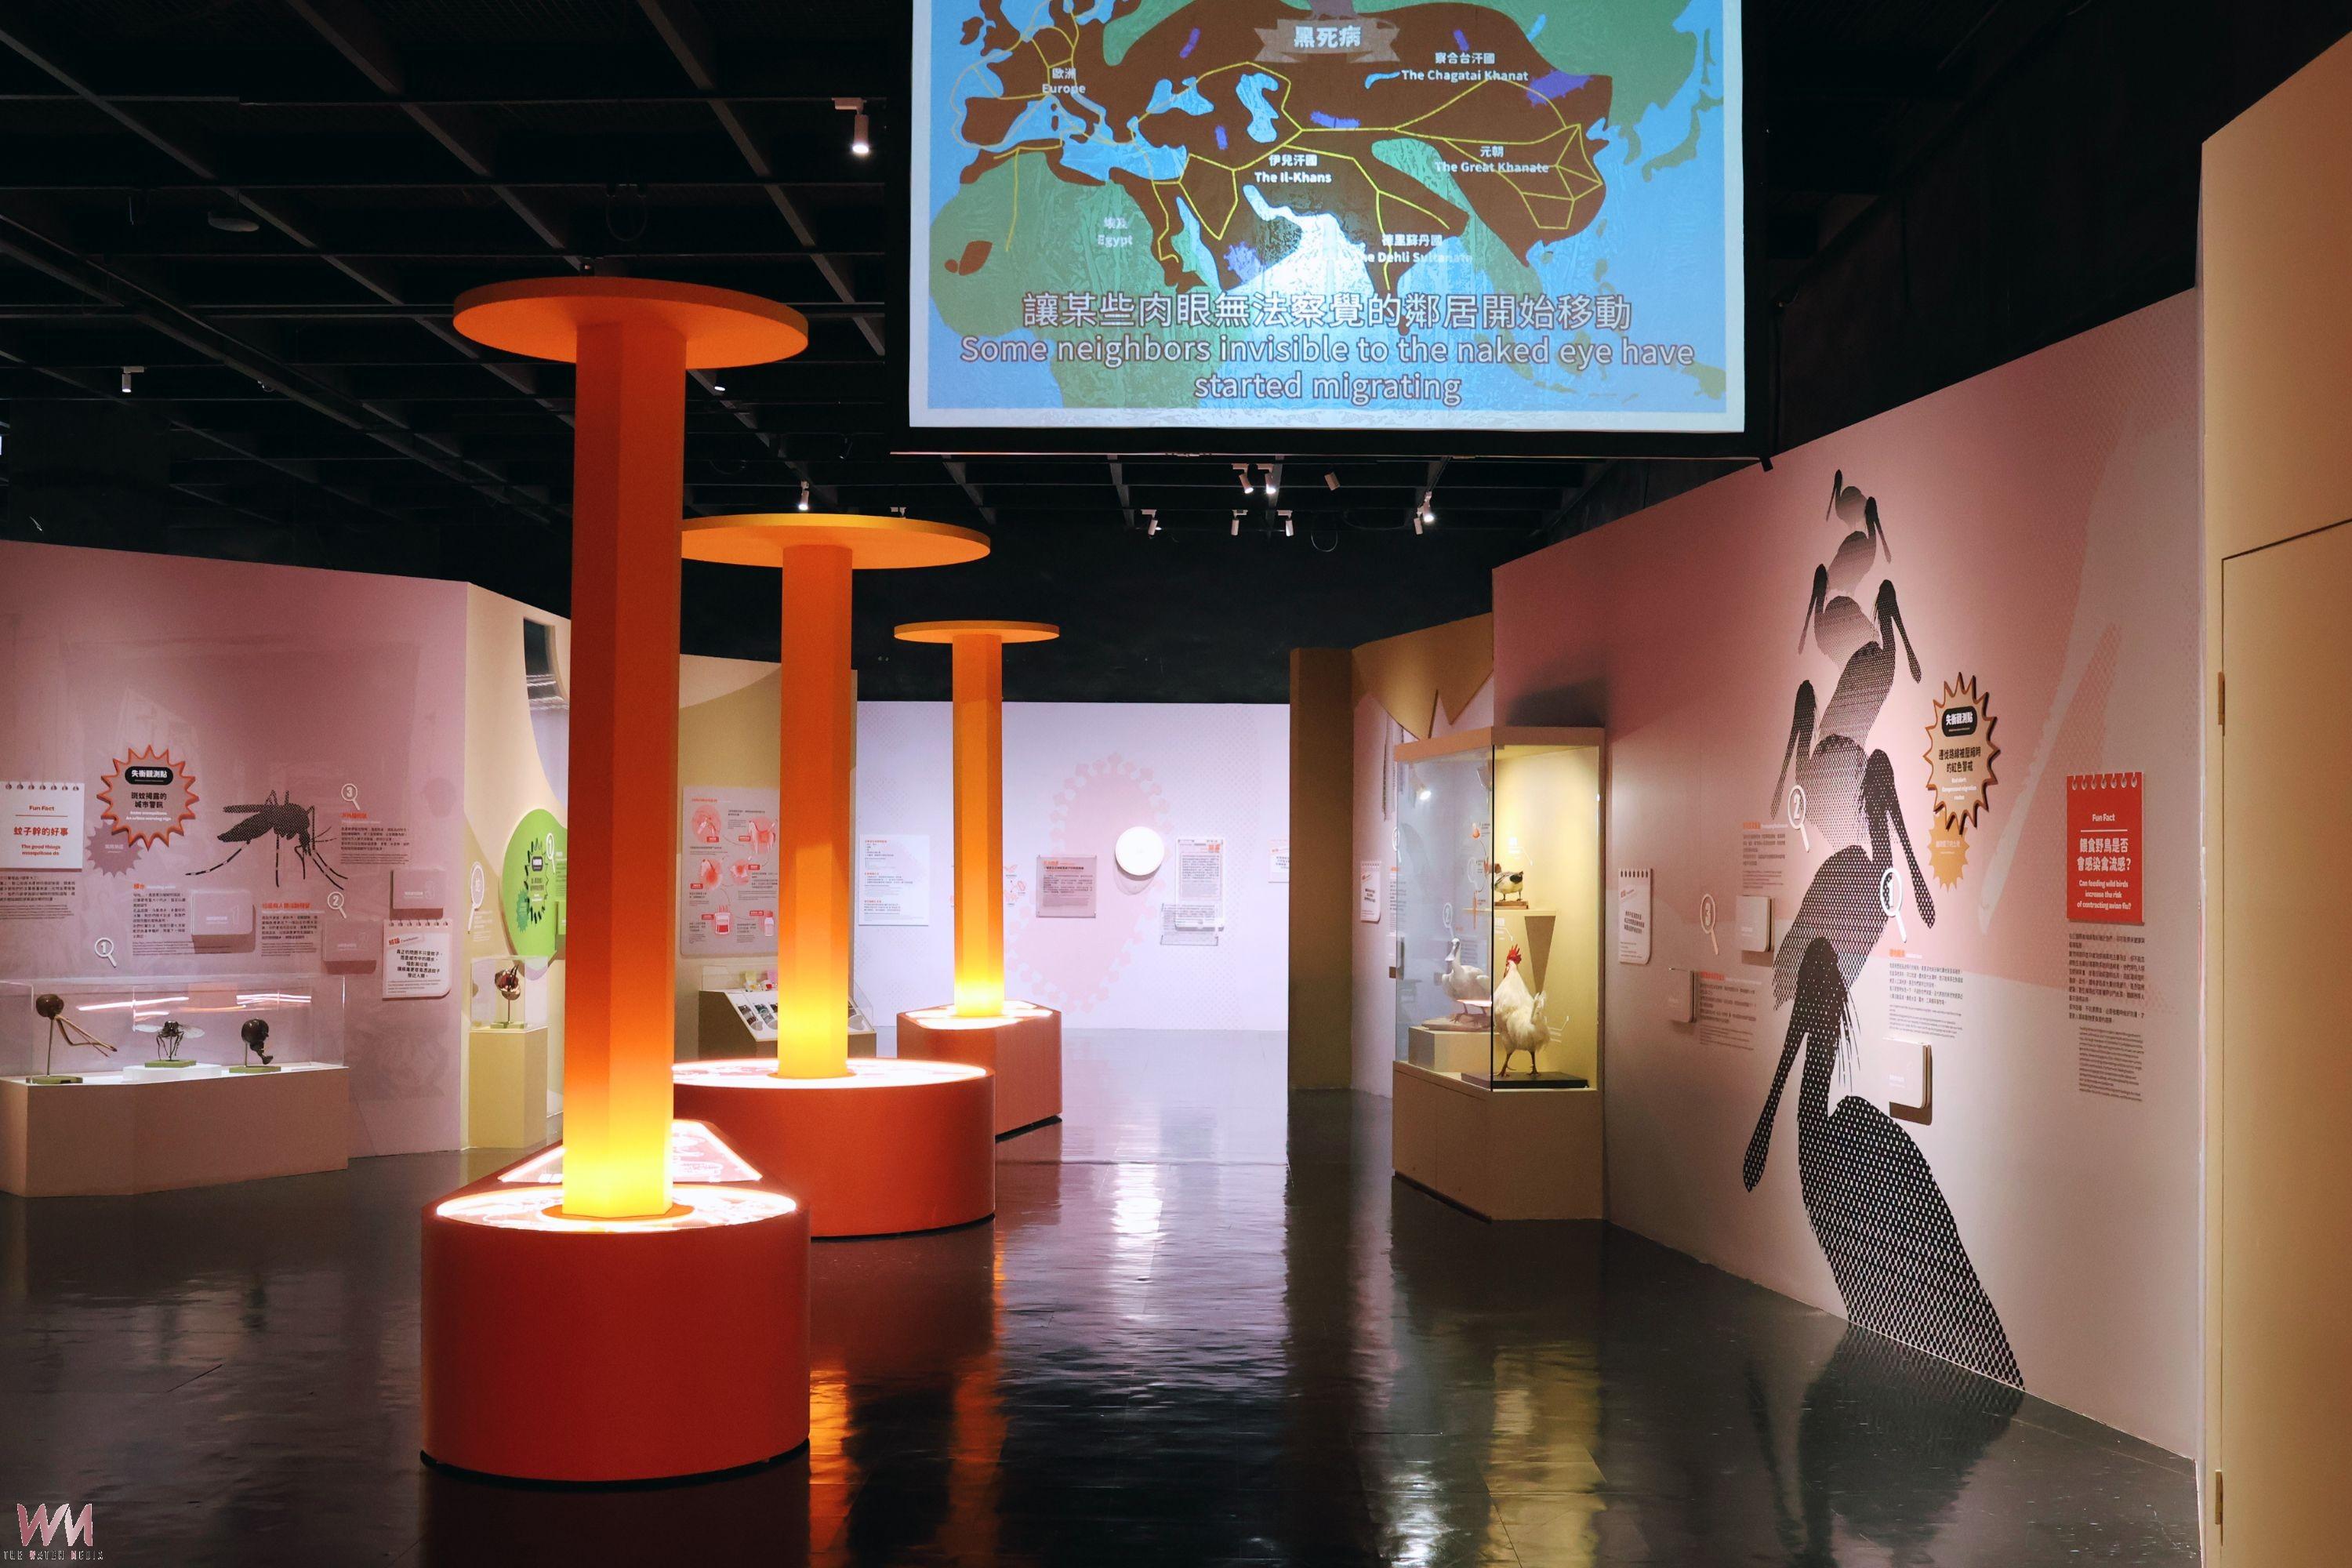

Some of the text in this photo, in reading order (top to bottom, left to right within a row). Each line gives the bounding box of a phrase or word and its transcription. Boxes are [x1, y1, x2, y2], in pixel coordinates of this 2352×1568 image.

[1294, 24, 1361, 48] 黑死病
[1435, 52, 1495, 64] 察合台汗國
[1052, 67, 1076, 79] 歐洲
[1401, 70, 1529, 83] The Chagatai Khanat
[1042, 83, 1086, 96] Europe
[1480, 146, 1504, 157] 元朝
[1269, 154, 1318, 166] 伊兒汗國
[1435, 162, 1549, 173] The Great Khanate
[1254, 171, 1332, 183] The Il-Khans
[1377, 252, 1410, 263] Dehli
[1022, 291, 1632, 330] 讓某些肉眼無法察覺的鄰居開始移動
[960, 334, 1695, 371] Some neighbors invisible to the naked eye have
[1194, 370, 1462, 407] started migrating
[347, 786, 353, 797] 3
[1794, 793, 1800, 819] 2
[2103, 813, 2115, 822] Fact
[13, 826, 68, 837] 蚊子幹的好事
[2079, 837, 2129, 854] 餵食野鳥是否
[1887, 880, 1894, 908] 1
[333, 895, 339, 906] 2
[1704, 902, 1711, 926] 3
[100, 942, 107, 954] 1
